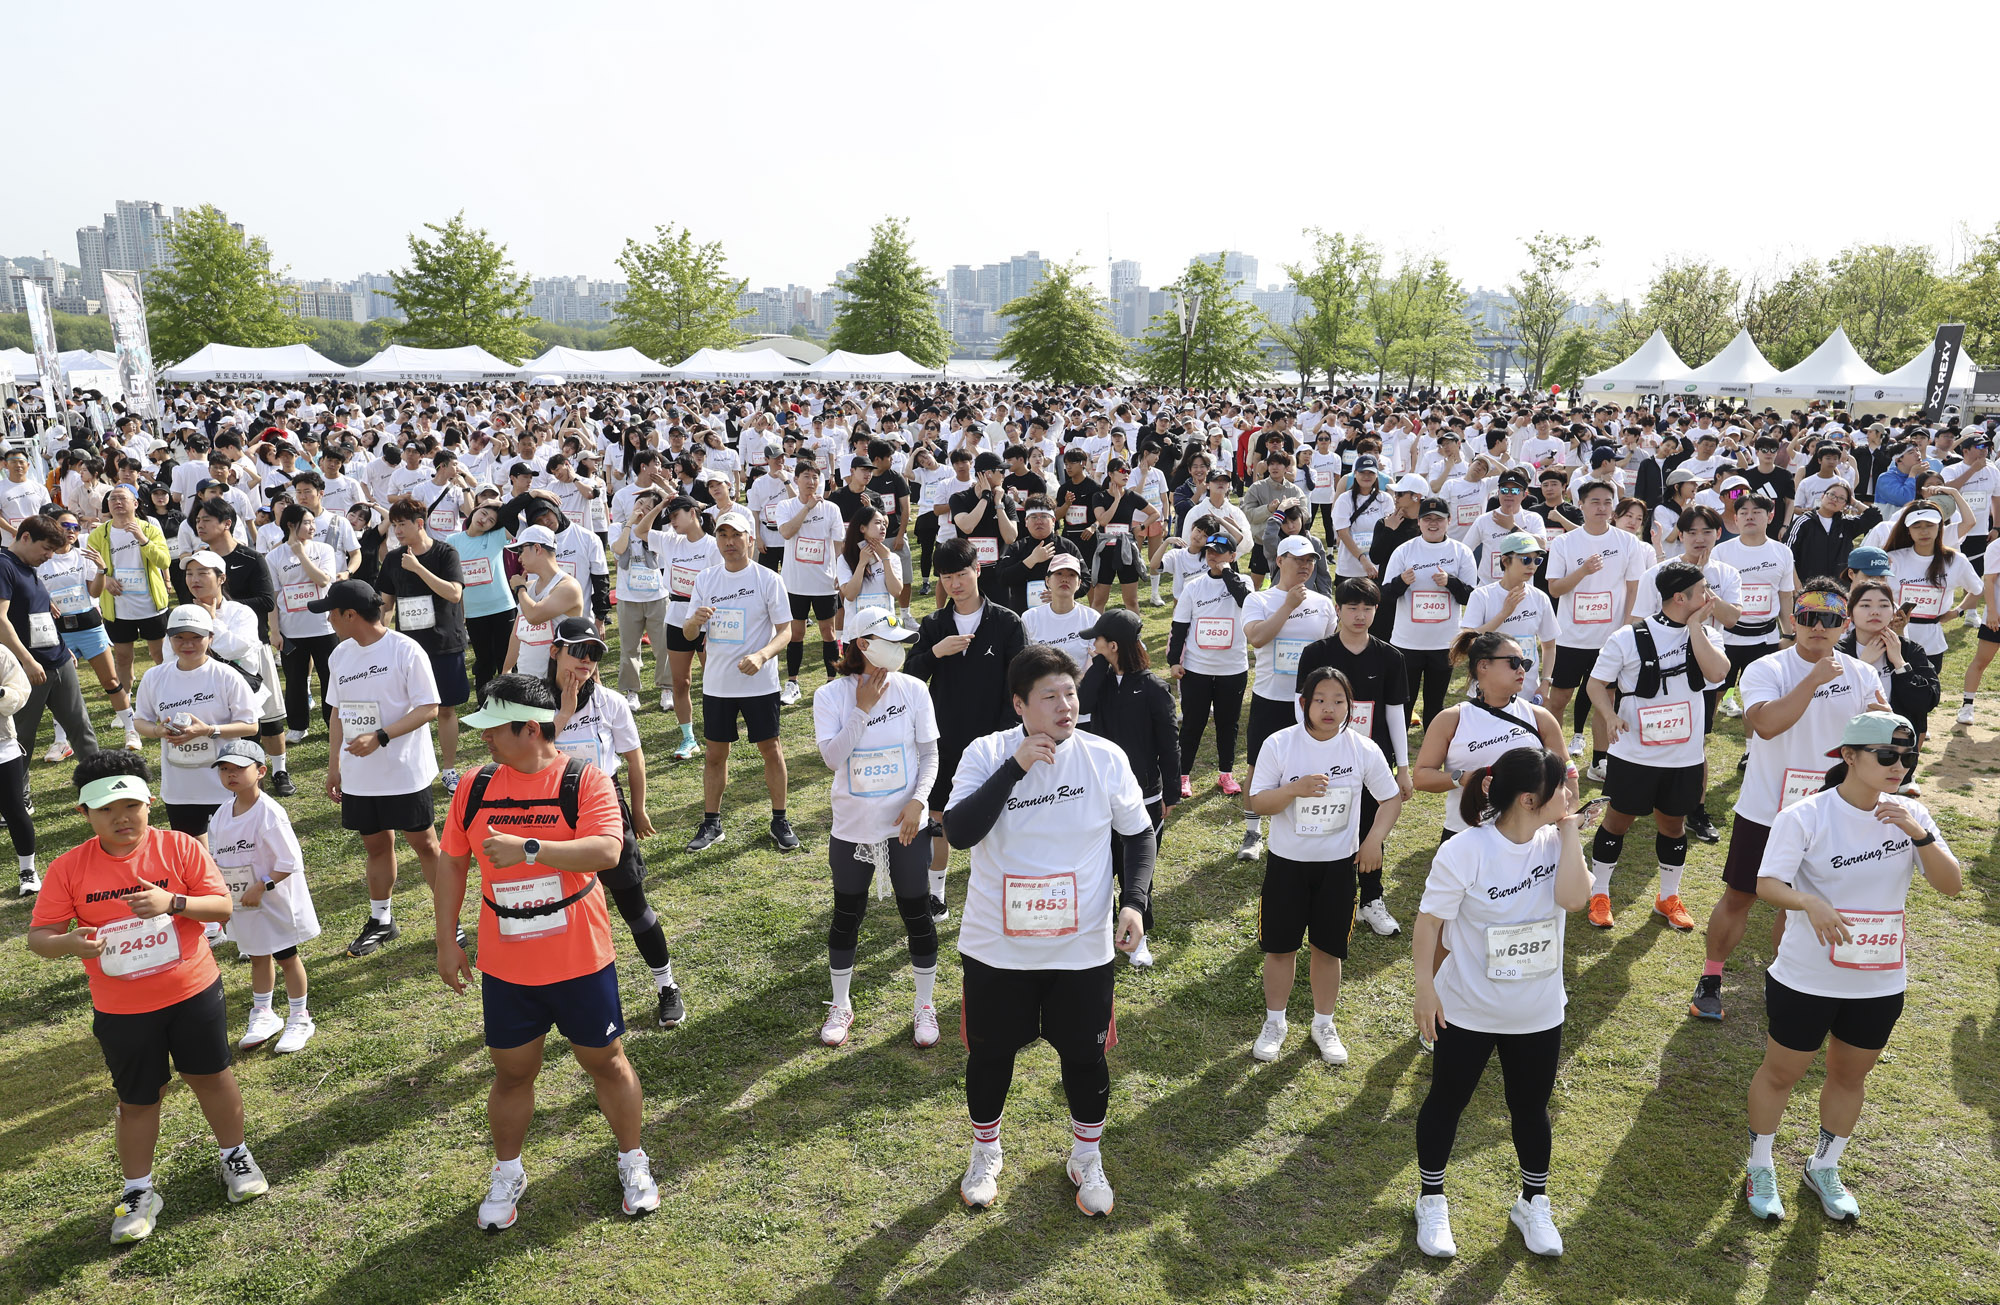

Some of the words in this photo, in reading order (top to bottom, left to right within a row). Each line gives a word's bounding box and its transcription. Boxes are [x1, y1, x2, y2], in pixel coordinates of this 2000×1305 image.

[1937, 340, 1951, 384] REXY
[215, 372, 263, 380] 포토존대기실
[1603, 549, 1619, 558] Run
[467, 567, 487, 576] 3445
[1412, 561, 1440, 571] Burning
[678, 577, 695, 587] 3084
[294, 591, 315, 600] 3669
[710, 593, 738, 605] Burning
[738, 588, 755, 596] Run
[1913, 596, 1938, 605] 3531
[1303, 607, 1319, 616] Run
[1422, 602, 1446, 610] 3403
[1585, 603, 1608, 611] 1293
[405, 607, 428, 617] 5232
[1522, 610, 1537, 618] Run
[525, 623, 547, 632] 1283
[716, 620, 740, 629] 7168
[1206, 629, 1229, 637] 3630
[1658, 648, 1680, 661] urning
[339, 671, 368, 686] Burning
[368, 665, 388, 675] Run
[159, 697, 192, 712] Burning
[192, 692, 215, 704] Run
[351, 716, 376, 725] 5038
[579, 713, 601, 725] Run
[866, 714, 887, 727] ning
[887, 704, 907, 718] Run
[1656, 717, 1684, 729] 1271
[1468, 734, 1510, 752] Burning
[1510, 727, 1530, 739] Run
[177, 742, 209, 753] 6058
[853, 767, 862, 776] W
[864, 763, 899, 776] 8333
[1330, 765, 1354, 777] Run
[1006, 793, 1055, 810] Burning
[1056, 785, 1085, 800] Run
[1311, 803, 1346, 815] 5173
[486, 815, 536, 825] BURNING
[535, 814, 560, 824] RUN
[216, 846, 236, 855] urning
[236, 839, 255, 850] Run
[1830, 849, 1884, 869] Burning
[1882, 838, 1911, 855] Run
[229, 882, 249, 892] 057
[496, 884, 521, 893] BURNING
[1487, 877, 1533, 900] Burning
[1011, 900, 1022, 909] M
[1025, 898, 1068, 911] 1853
[100, 922, 128, 935] BURNING
[129, 919, 144, 930] RUN
[105, 945, 116, 956] M
[119, 931, 169, 956] 2430
[1856, 933, 1898, 945] 3456
[1495, 948, 1506, 958] W
[1507, 939, 1551, 957] 6387
[1495, 968, 1516, 977] D-30
